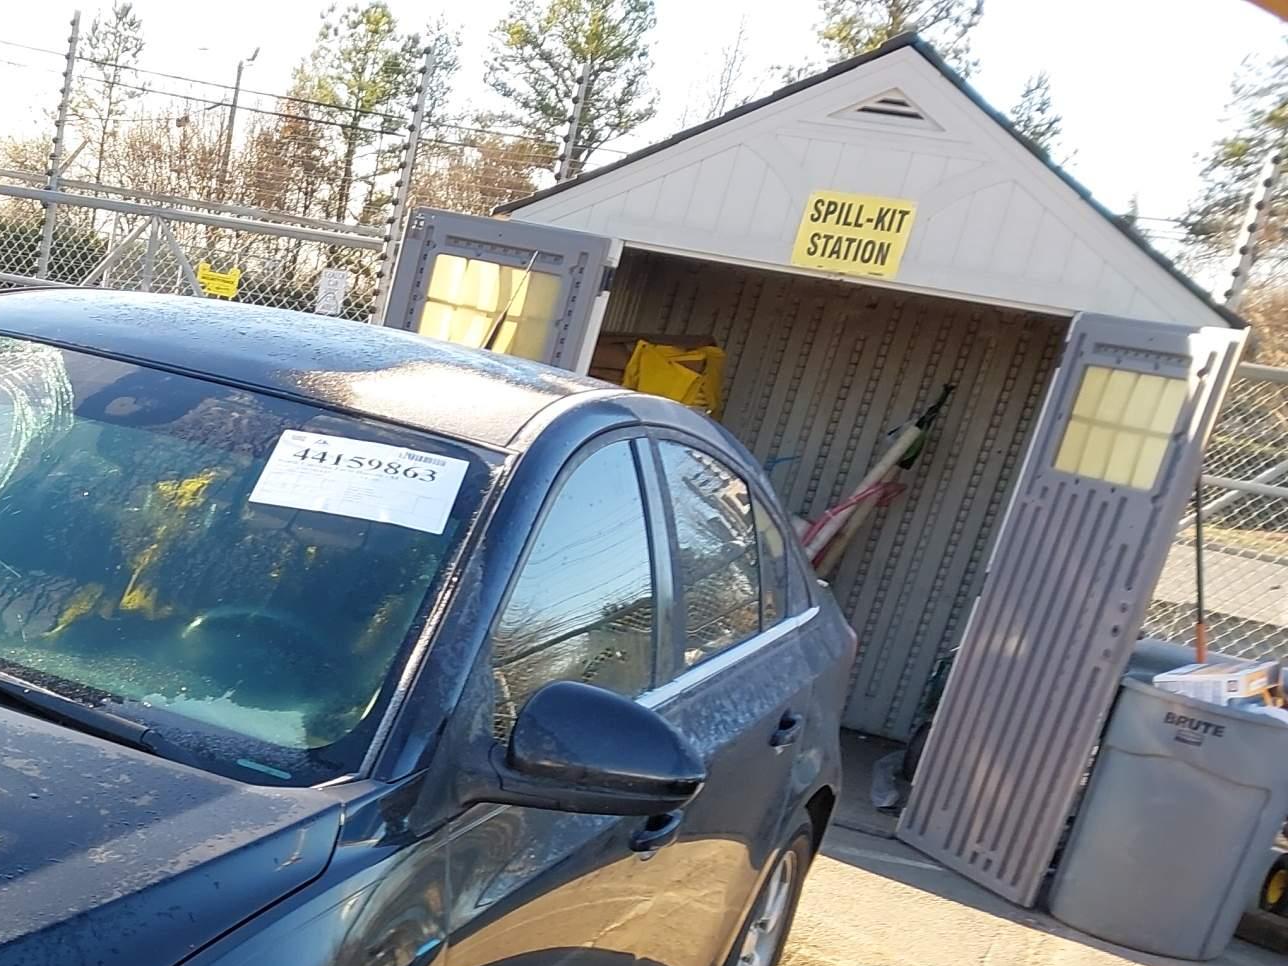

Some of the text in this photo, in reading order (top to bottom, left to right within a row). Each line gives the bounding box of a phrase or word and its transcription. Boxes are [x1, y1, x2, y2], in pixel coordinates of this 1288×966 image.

[810, 198, 911, 234] SPILL-KIT
[807, 232, 892, 267] STATION
[292, 447, 439, 483] 44159863
[1163, 711, 1227, 737] BRUTE
